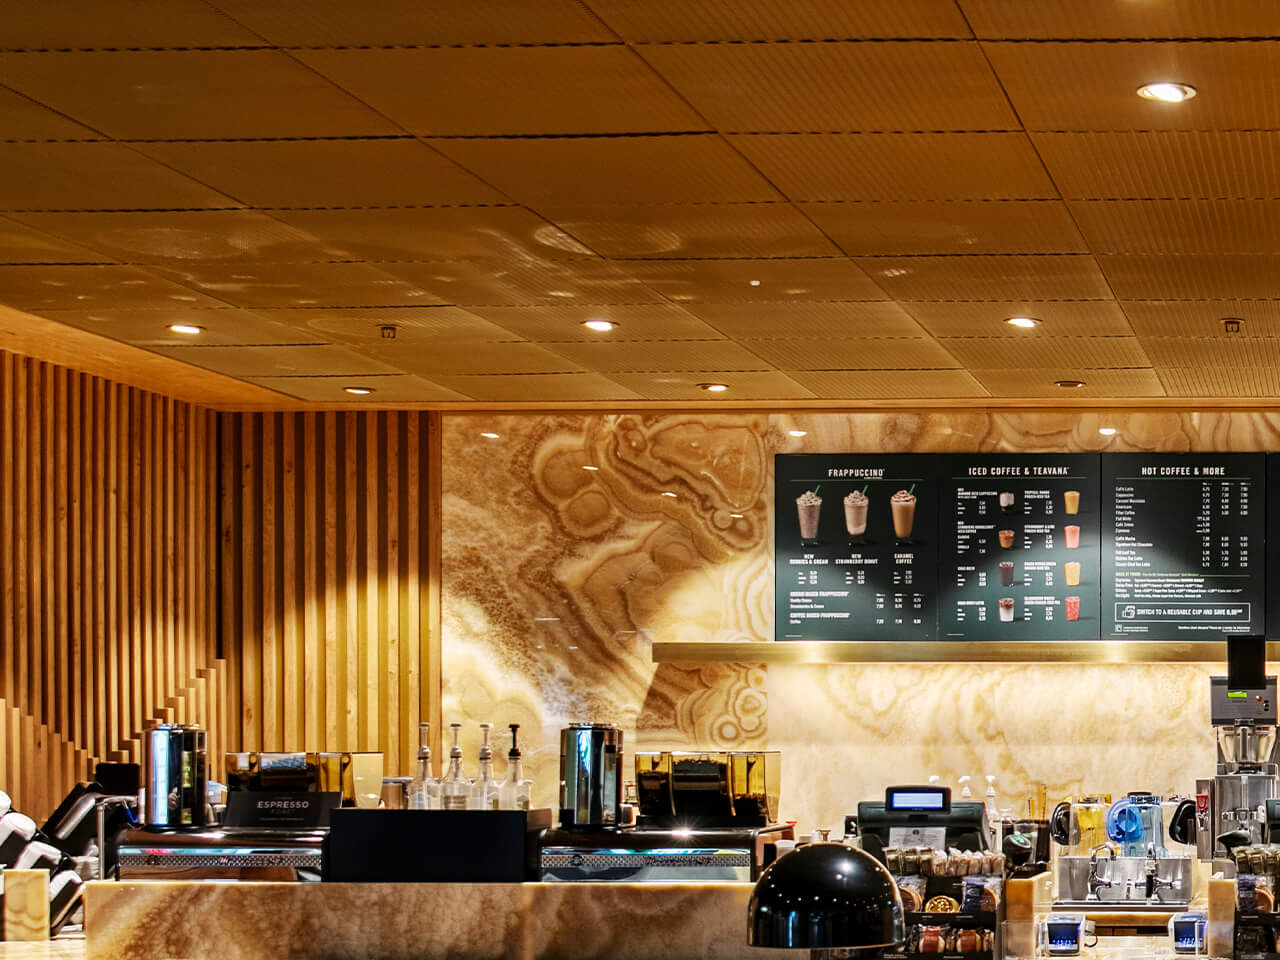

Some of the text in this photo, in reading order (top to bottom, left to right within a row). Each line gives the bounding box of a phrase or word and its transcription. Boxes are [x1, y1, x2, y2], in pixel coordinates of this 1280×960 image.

[968, 467, 987, 476] ICED
[991, 467, 1020, 476] COFFEE
[1024, 467, 1030, 476] &
[1142, 467, 1225, 475] HOT COFFEE & MORE
[256, 800, 310, 808] ESPRESSO
